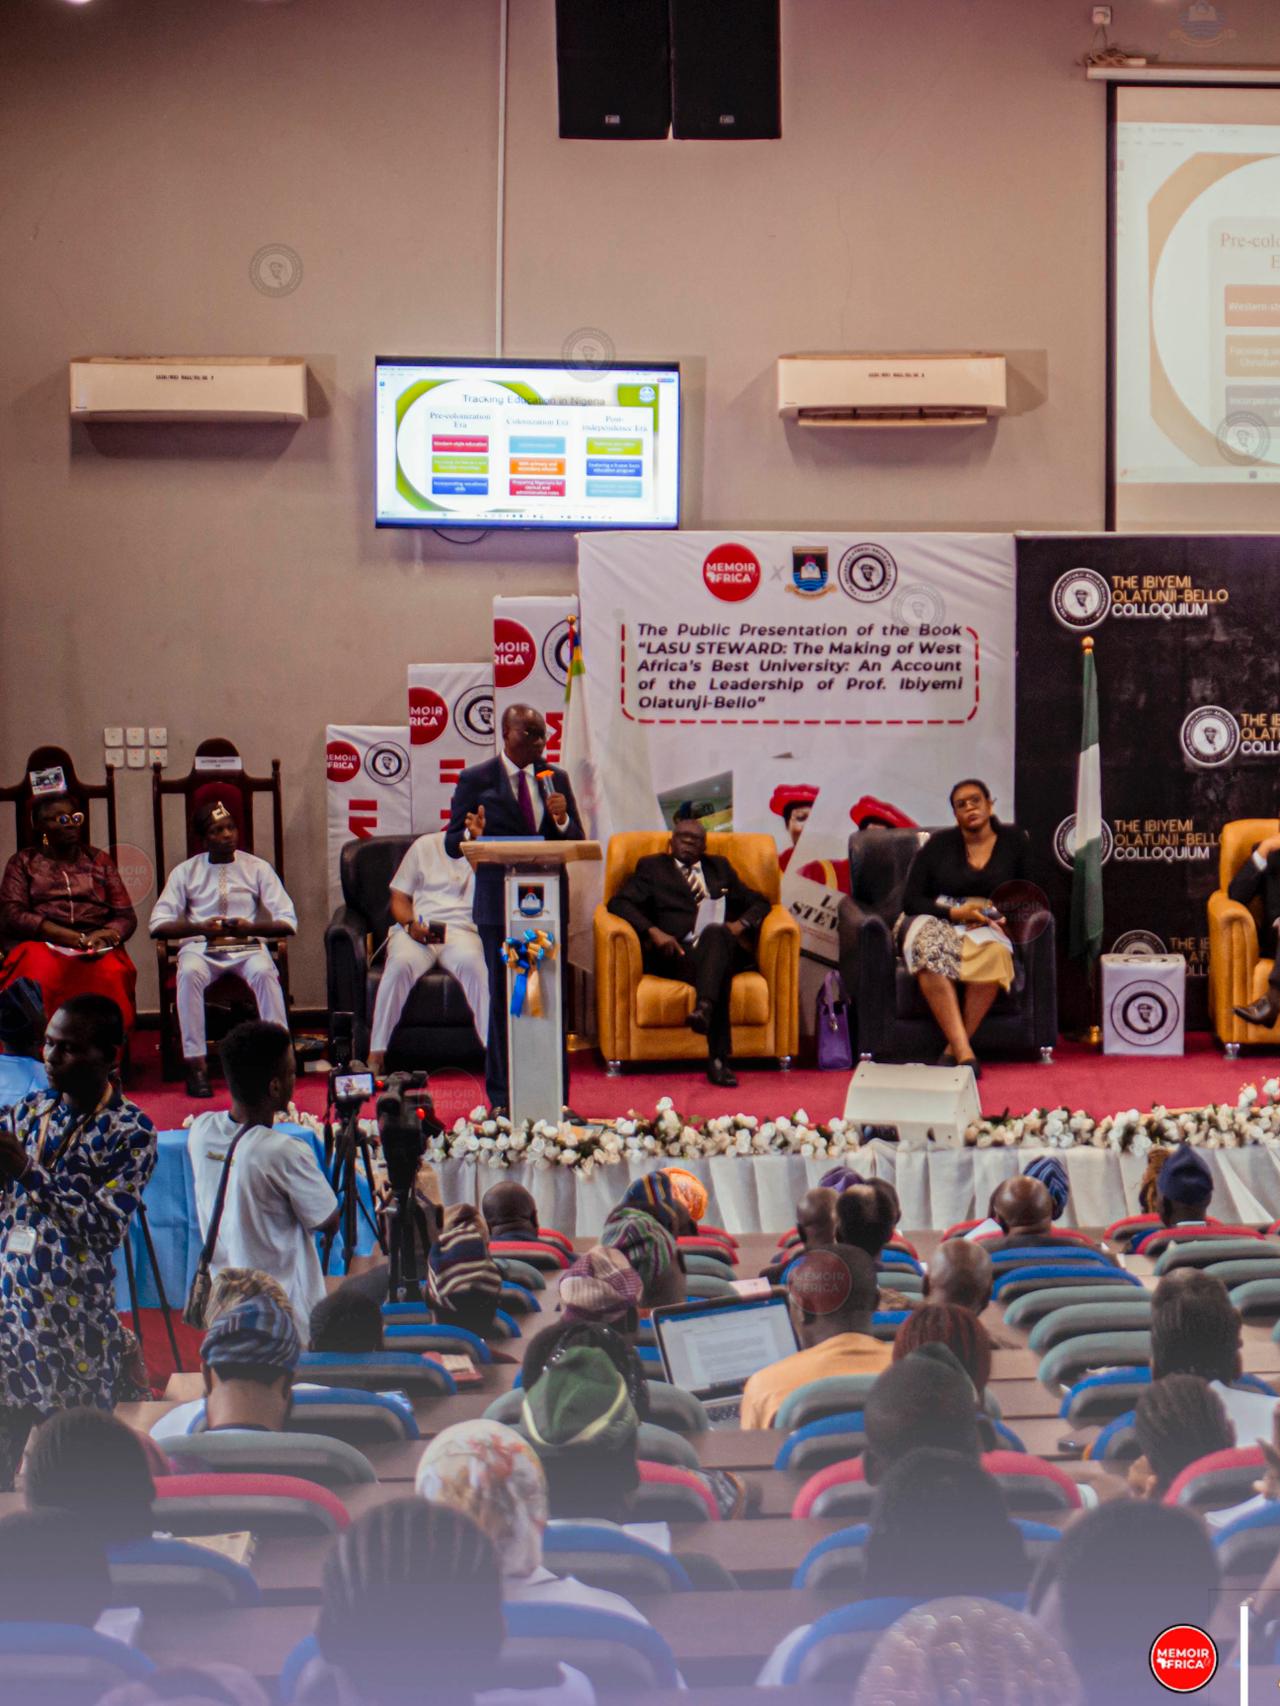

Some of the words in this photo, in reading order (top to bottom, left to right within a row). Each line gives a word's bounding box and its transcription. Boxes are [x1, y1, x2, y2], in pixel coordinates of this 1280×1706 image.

[464, 394, 504, 406] Tracking
[508, 395, 558, 406] Education
[706, 562, 756, 572] MEMOIR
[1112, 576, 1140, 589] THE
[1144, 576, 1192, 589] IBIYEMI
[1112, 589, 1228, 602] OLATUNJI-BELLO
[1112, 603, 1208, 618] COLLOQUIUM
[638, 624, 668, 636] The
[678, 623, 730, 636] Public
[740, 624, 847, 636] Presentation
[857, 624, 874, 636] of
[882, 624, 910, 636] the
[919, 624, 962, 636] Book
[696, 642, 787, 654] STEWARD:
[794, 642, 824, 654] The
[829, 642, 890, 656] Making
[897, 642, 914, 654] of
[919, 642, 962, 654] West
[638, 660, 702, 672] Africa's
[712, 660, 749, 672] Best
[759, 660, 850, 674] University:
[858, 660, 882, 672] An
[892, 660, 962, 672] Account
[638, 678, 656, 690] of
[669, 678, 696, 690] the
[710, 678, 804, 692] Leadership
[817, 678, 834, 690] of
[846, 678, 886, 690] Prof.
[900, 677, 964, 692] Ibiyemi
[1241, 713, 1267, 726] THE
[1114, 820, 1140, 832] THE
[1144, 819, 1194, 832] IBIYEMI
[1114, 846, 1210, 862] COLLOQUIUM
[1169, 937, 1196, 950] THE
